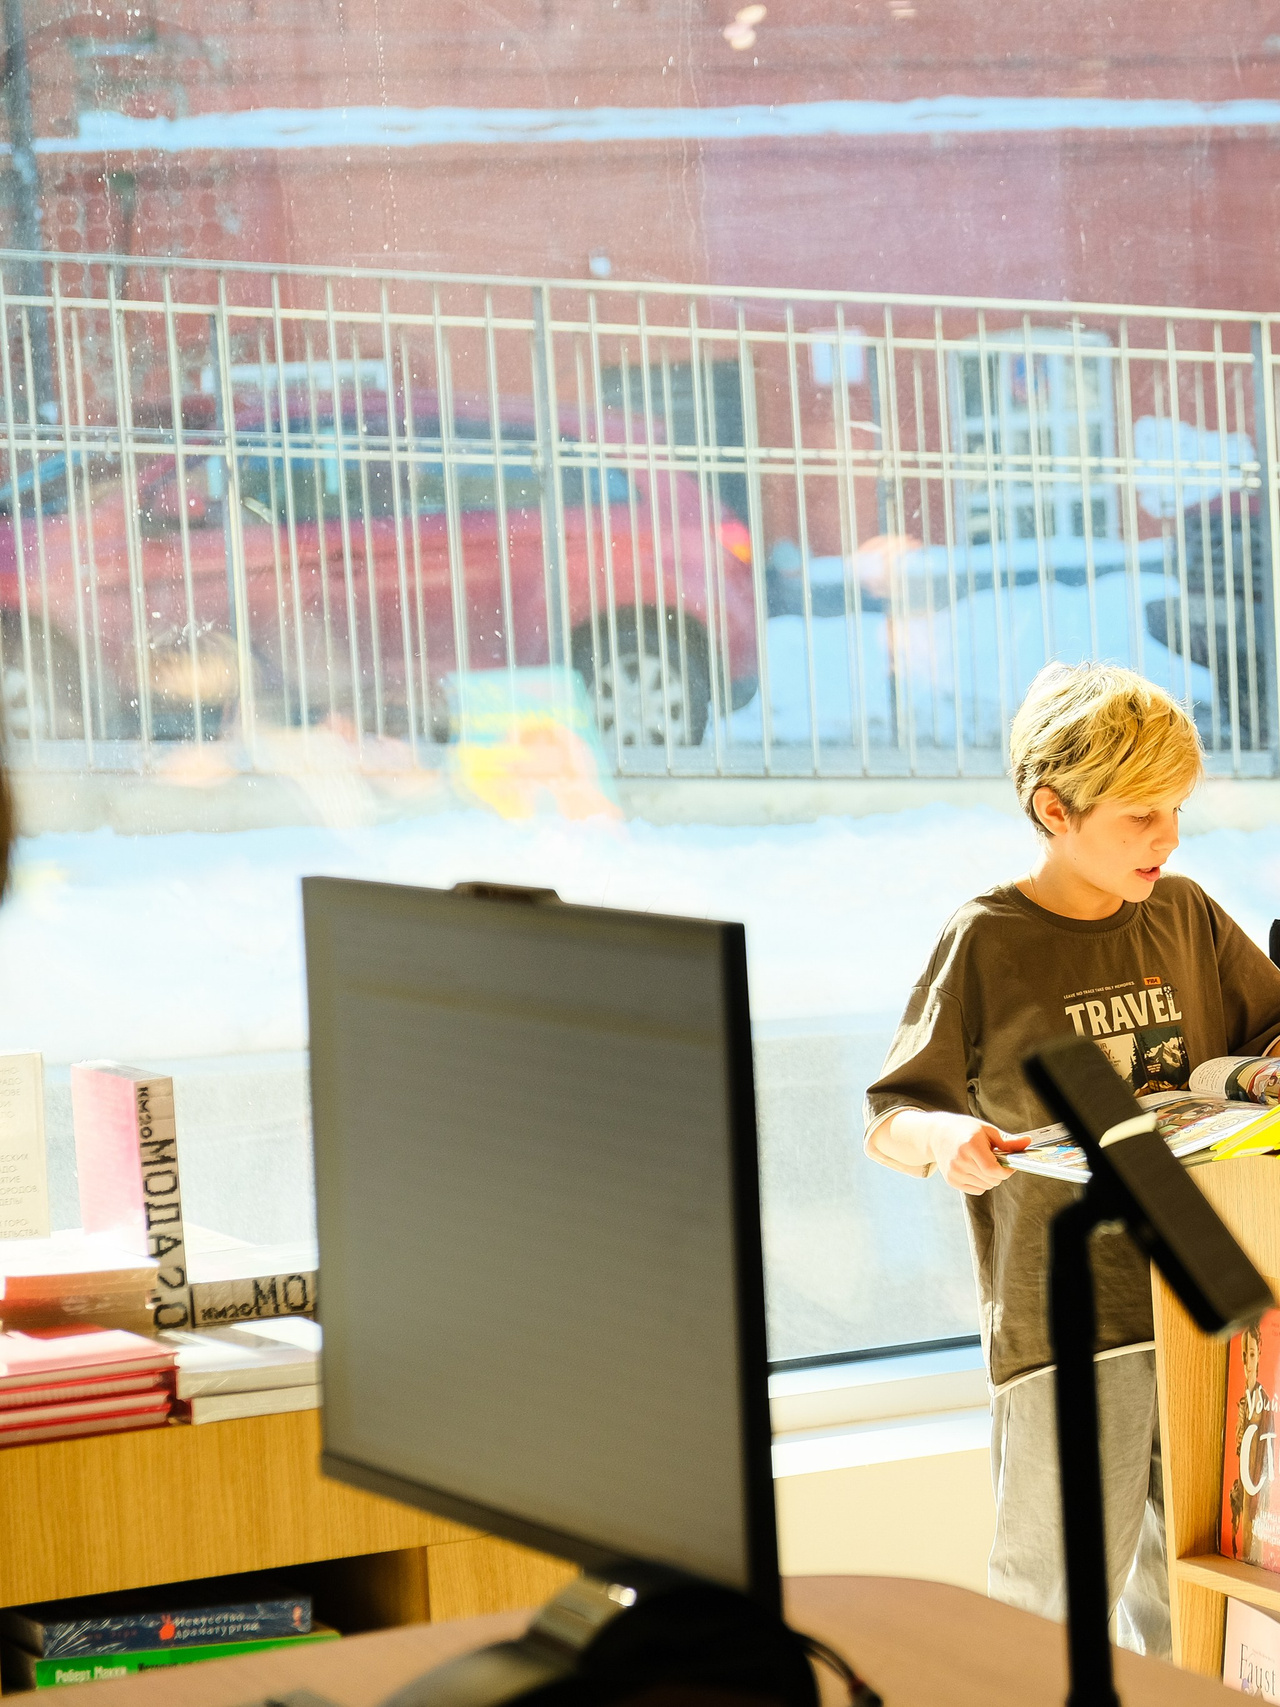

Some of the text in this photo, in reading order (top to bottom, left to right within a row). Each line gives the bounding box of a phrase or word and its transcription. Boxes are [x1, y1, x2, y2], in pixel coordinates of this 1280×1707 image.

[1065, 987, 1182, 1037] TRAVEL
[140, 1138, 182, 1259] МОДА
[1239, 1643, 1276, 1697] Faust
